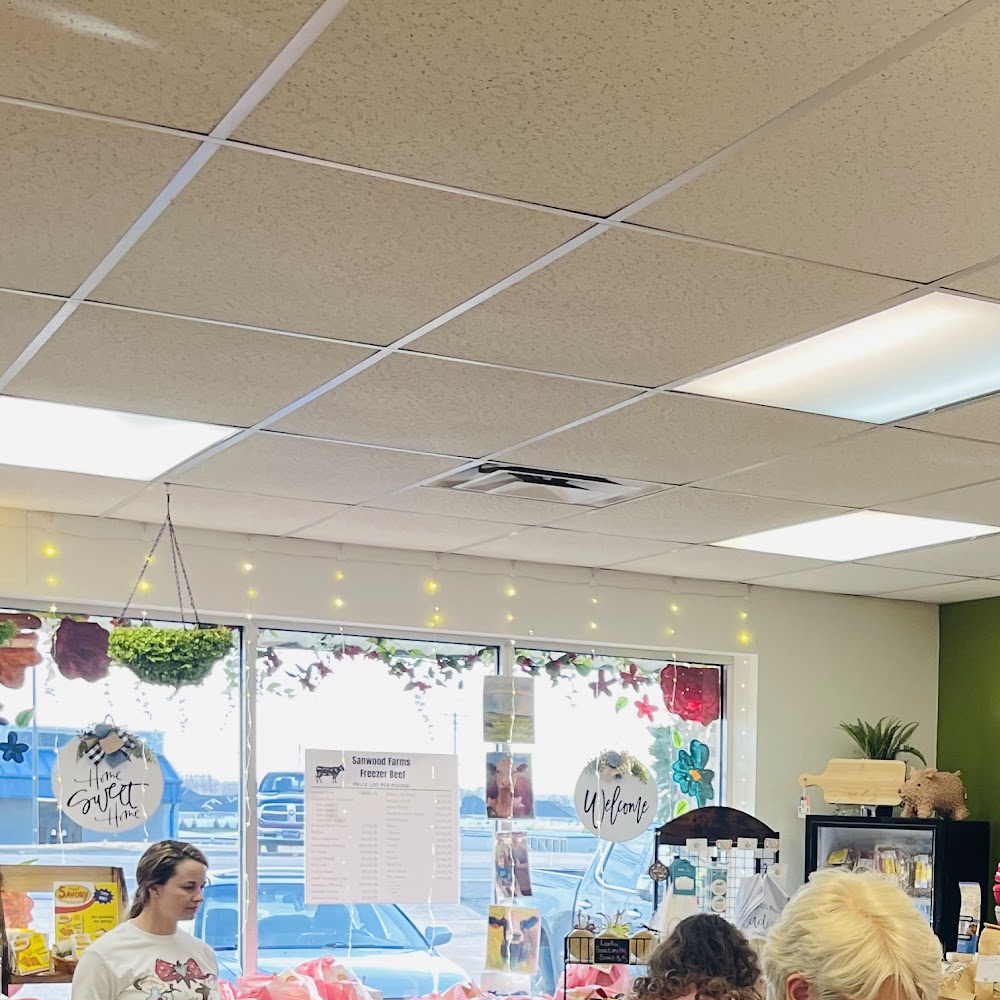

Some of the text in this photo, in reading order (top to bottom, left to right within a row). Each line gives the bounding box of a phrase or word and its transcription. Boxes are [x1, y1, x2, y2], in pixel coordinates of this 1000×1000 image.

[352, 756, 411, 767] Sanwood Farms
[360, 769, 406, 779] Freezer Beef
[74, 765, 122, 790] Home
[95, 803, 140, 828] Home
[583, 785, 650, 829] Welcome
